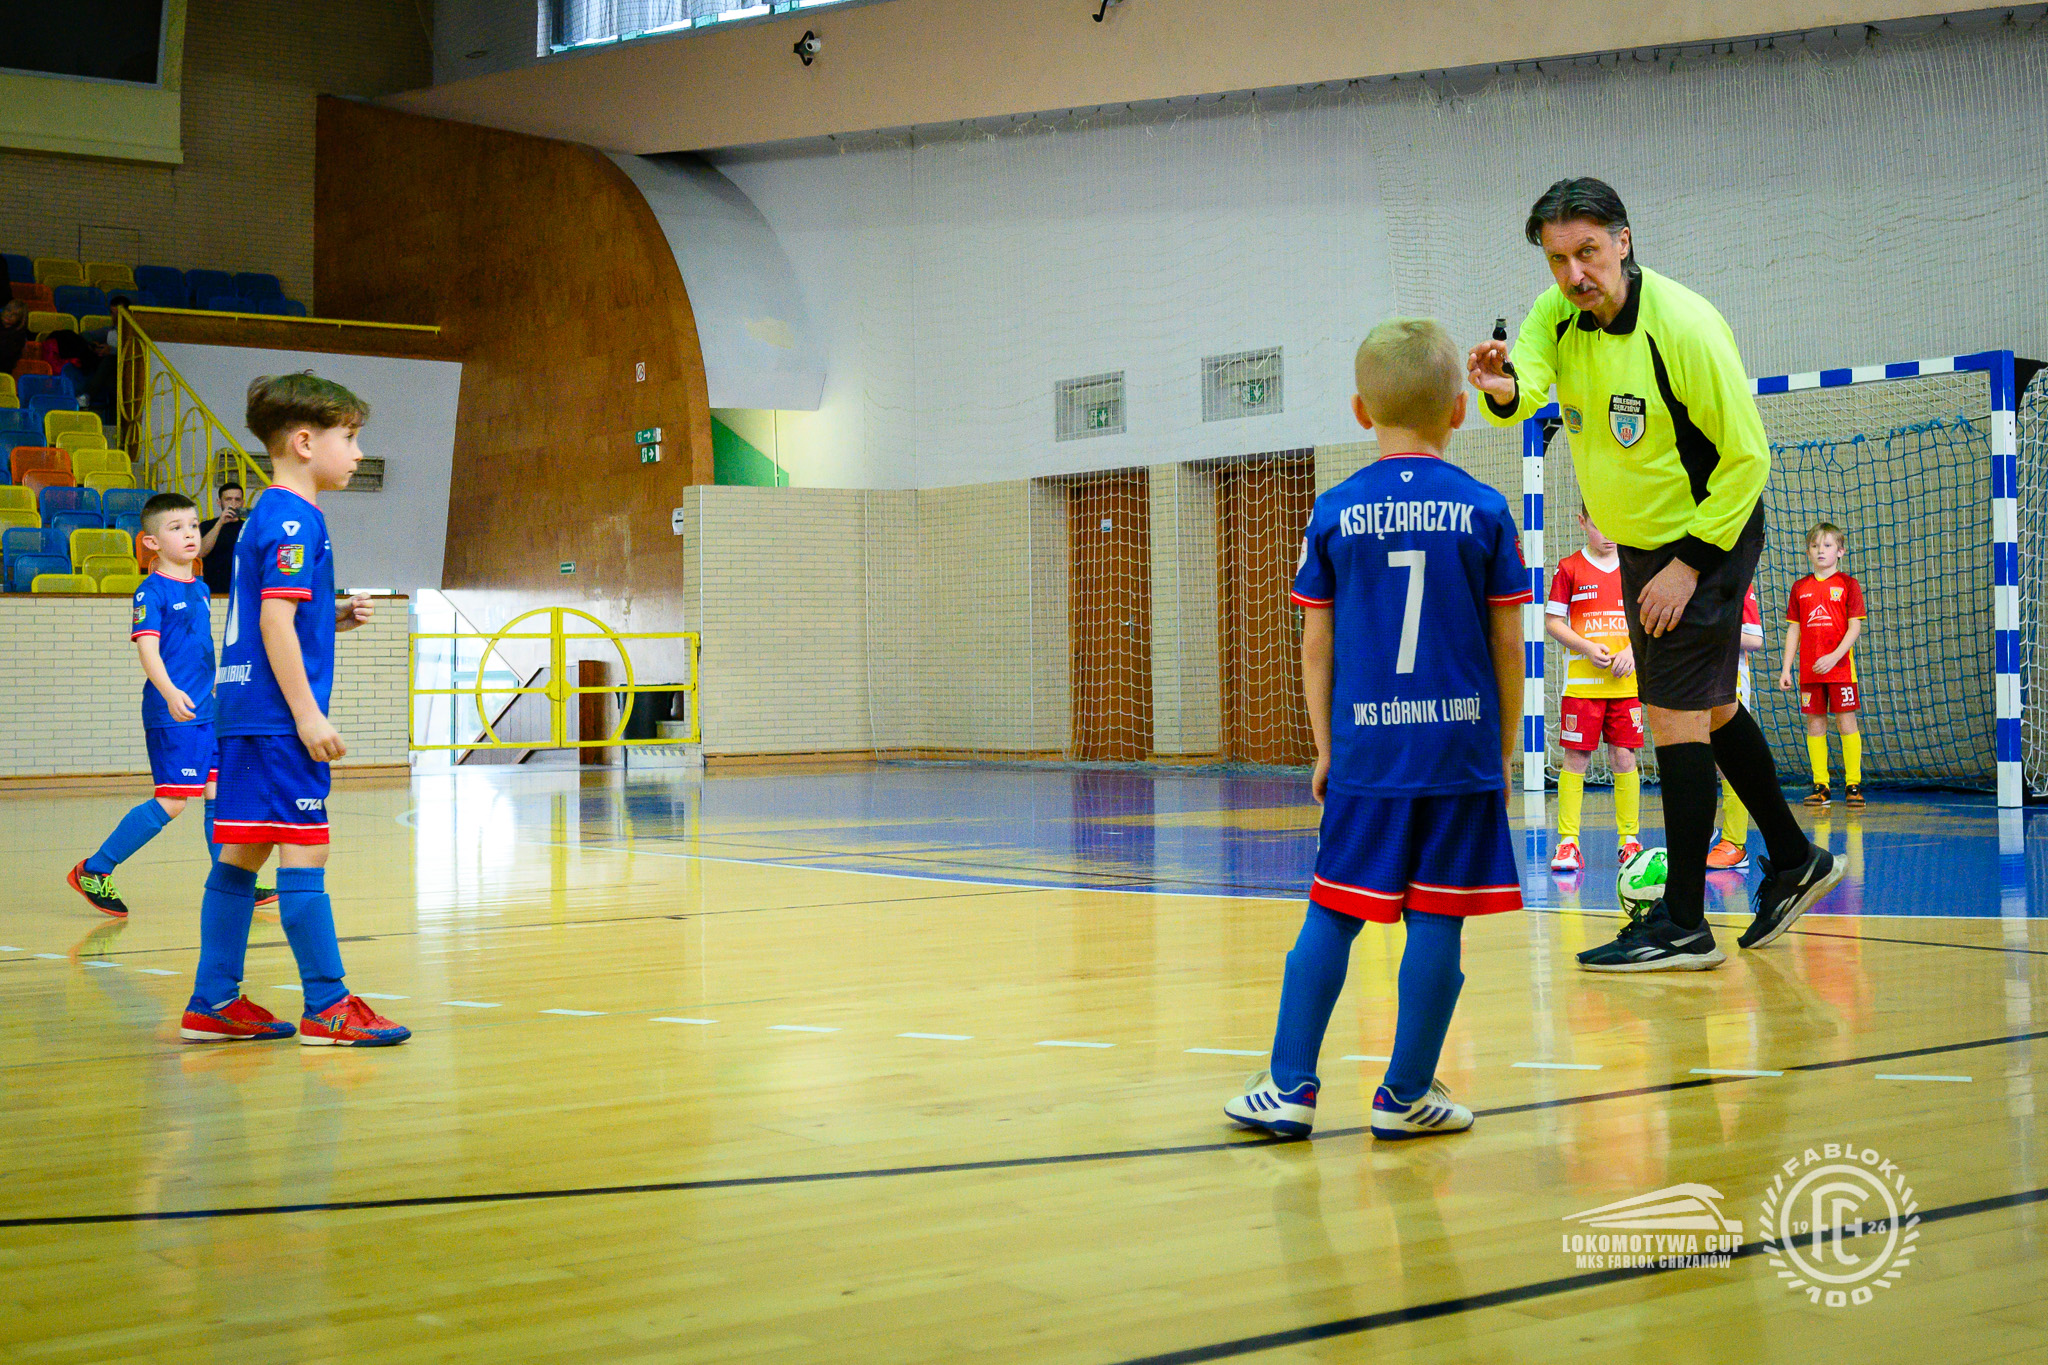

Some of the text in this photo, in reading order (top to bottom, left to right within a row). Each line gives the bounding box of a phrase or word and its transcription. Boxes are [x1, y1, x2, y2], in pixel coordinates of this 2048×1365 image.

[1339, 496, 1475, 540] KSIĘŻARCZYK
[1387, 550, 1426, 674] 7
[1381, 696, 1438, 725] GÓRNIK
[1441, 692, 1481, 725] LIBIĄŻ
[1840, 686, 1855, 702] 33
